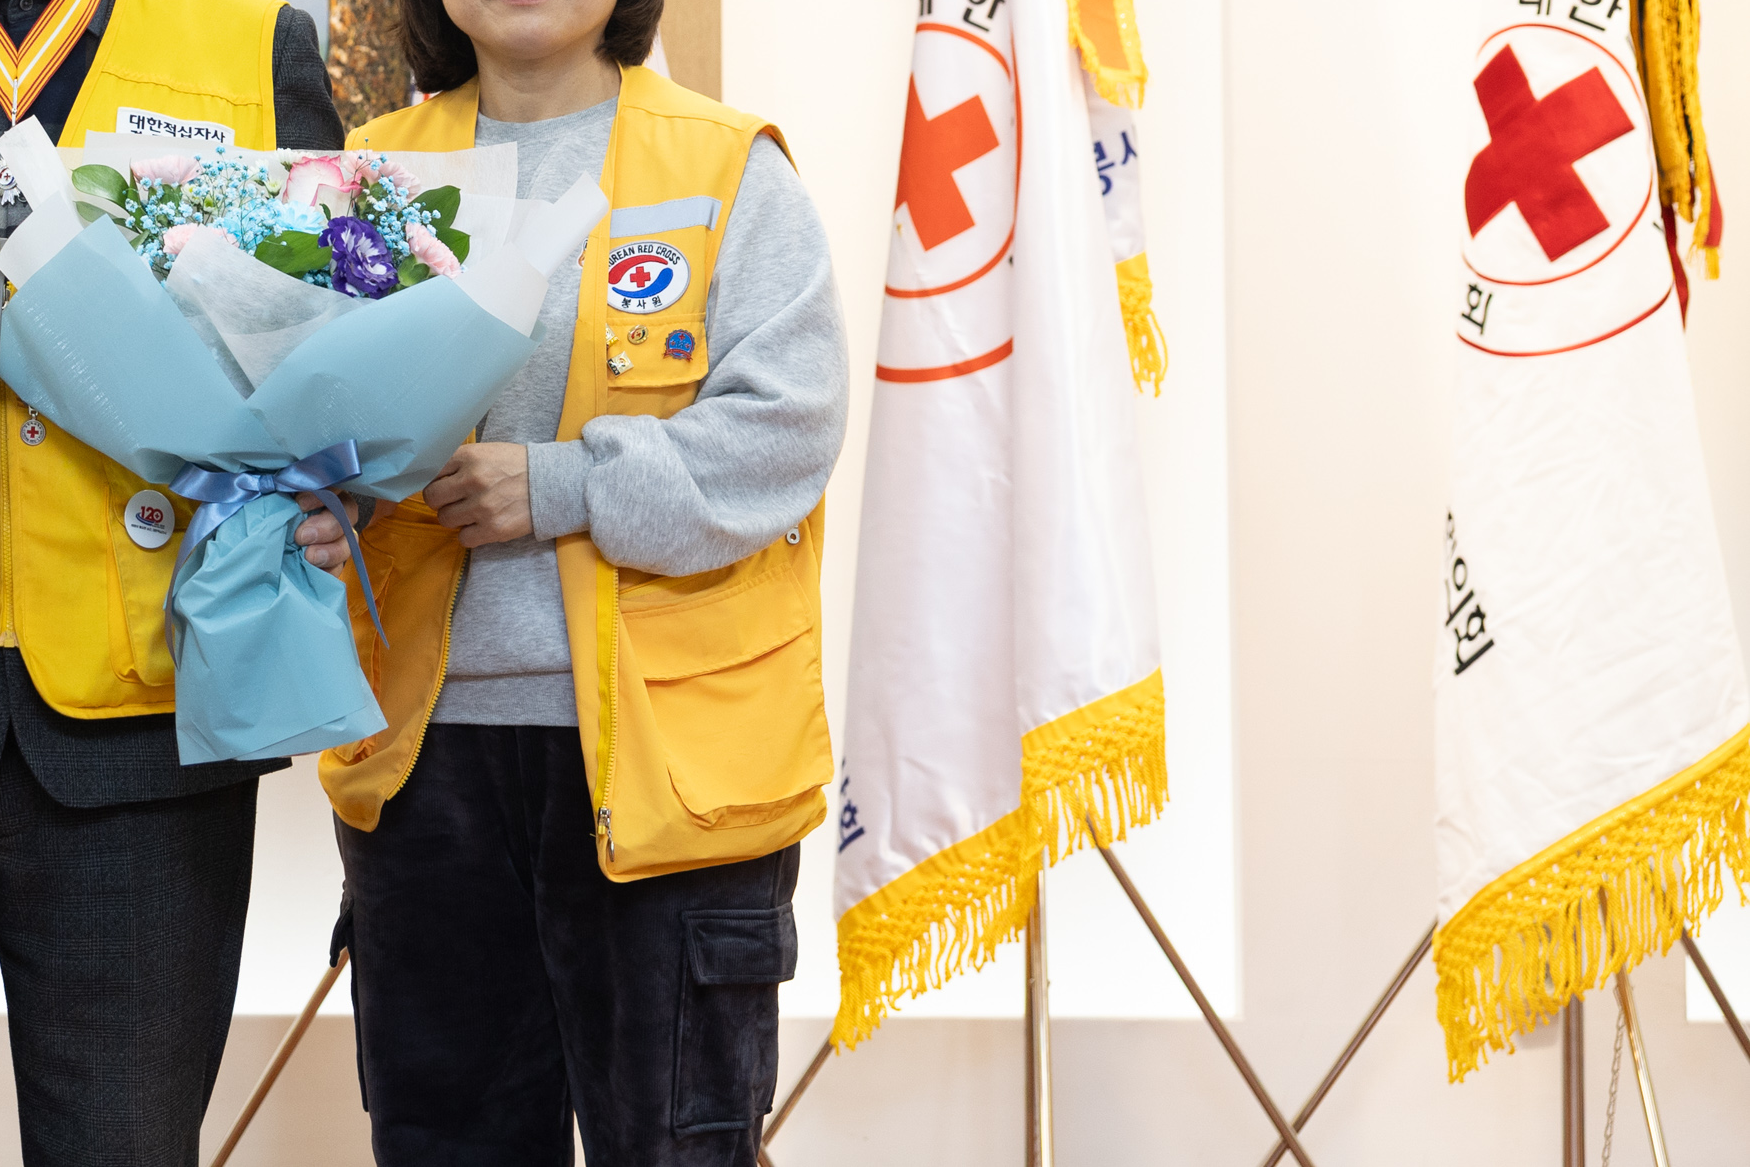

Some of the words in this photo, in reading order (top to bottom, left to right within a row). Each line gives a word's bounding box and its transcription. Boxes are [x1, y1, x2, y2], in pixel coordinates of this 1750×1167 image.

[129, 114, 226, 144] 대한적십자사
[609, 246, 635, 267] OREAN
[637, 244, 654, 254] RED
[655, 246, 681, 265] CROSS
[621, 295, 662, 309] 봉사원
[140, 506, 164, 524] 120
